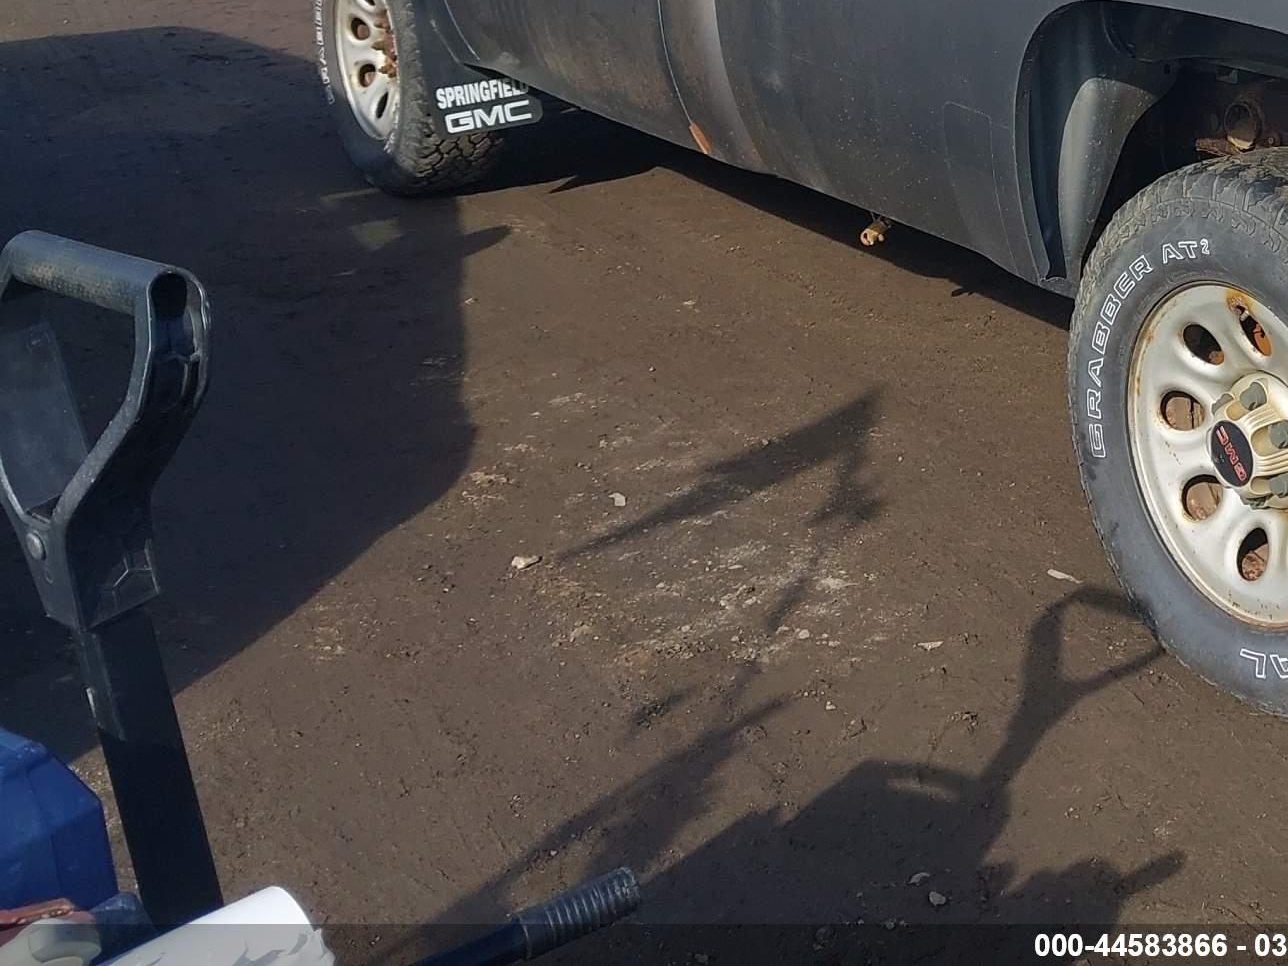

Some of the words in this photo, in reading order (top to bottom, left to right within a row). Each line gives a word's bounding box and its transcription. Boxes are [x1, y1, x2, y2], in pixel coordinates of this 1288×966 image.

[444, 99, 533, 134] GMC
[1086, 254, 1154, 459] GRABBER
[1215, 425, 1248, 482] GMC
